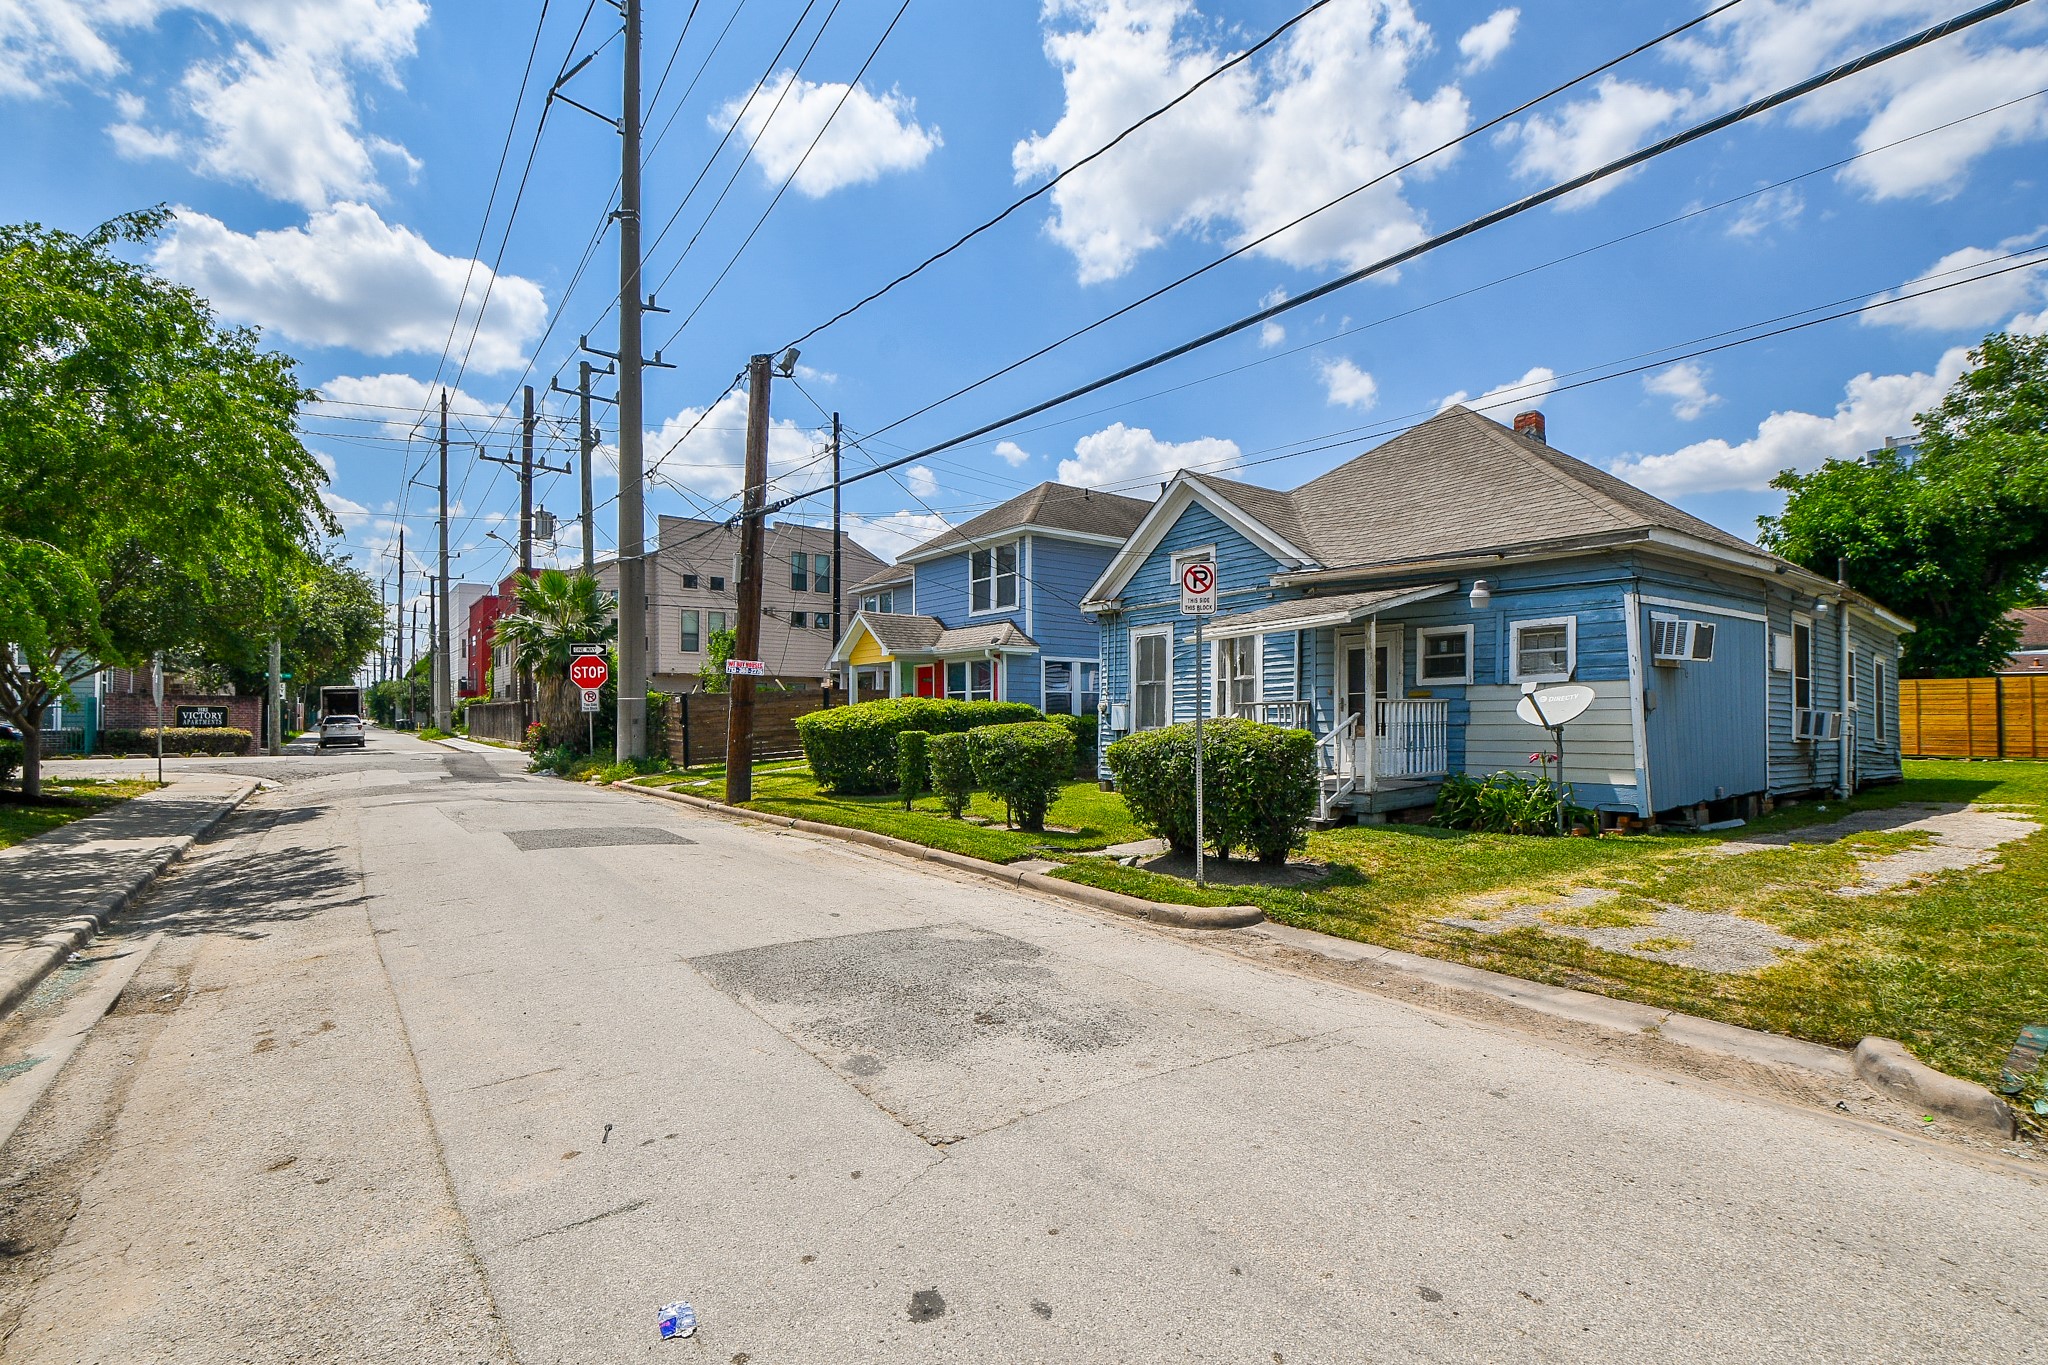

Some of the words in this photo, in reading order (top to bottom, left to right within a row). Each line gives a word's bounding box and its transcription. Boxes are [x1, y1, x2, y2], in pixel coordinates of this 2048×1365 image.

[573, 666, 605, 679] STOP
[1548, 693, 1579, 702] DIRECTV
[182, 711, 223, 720] VICTORY
